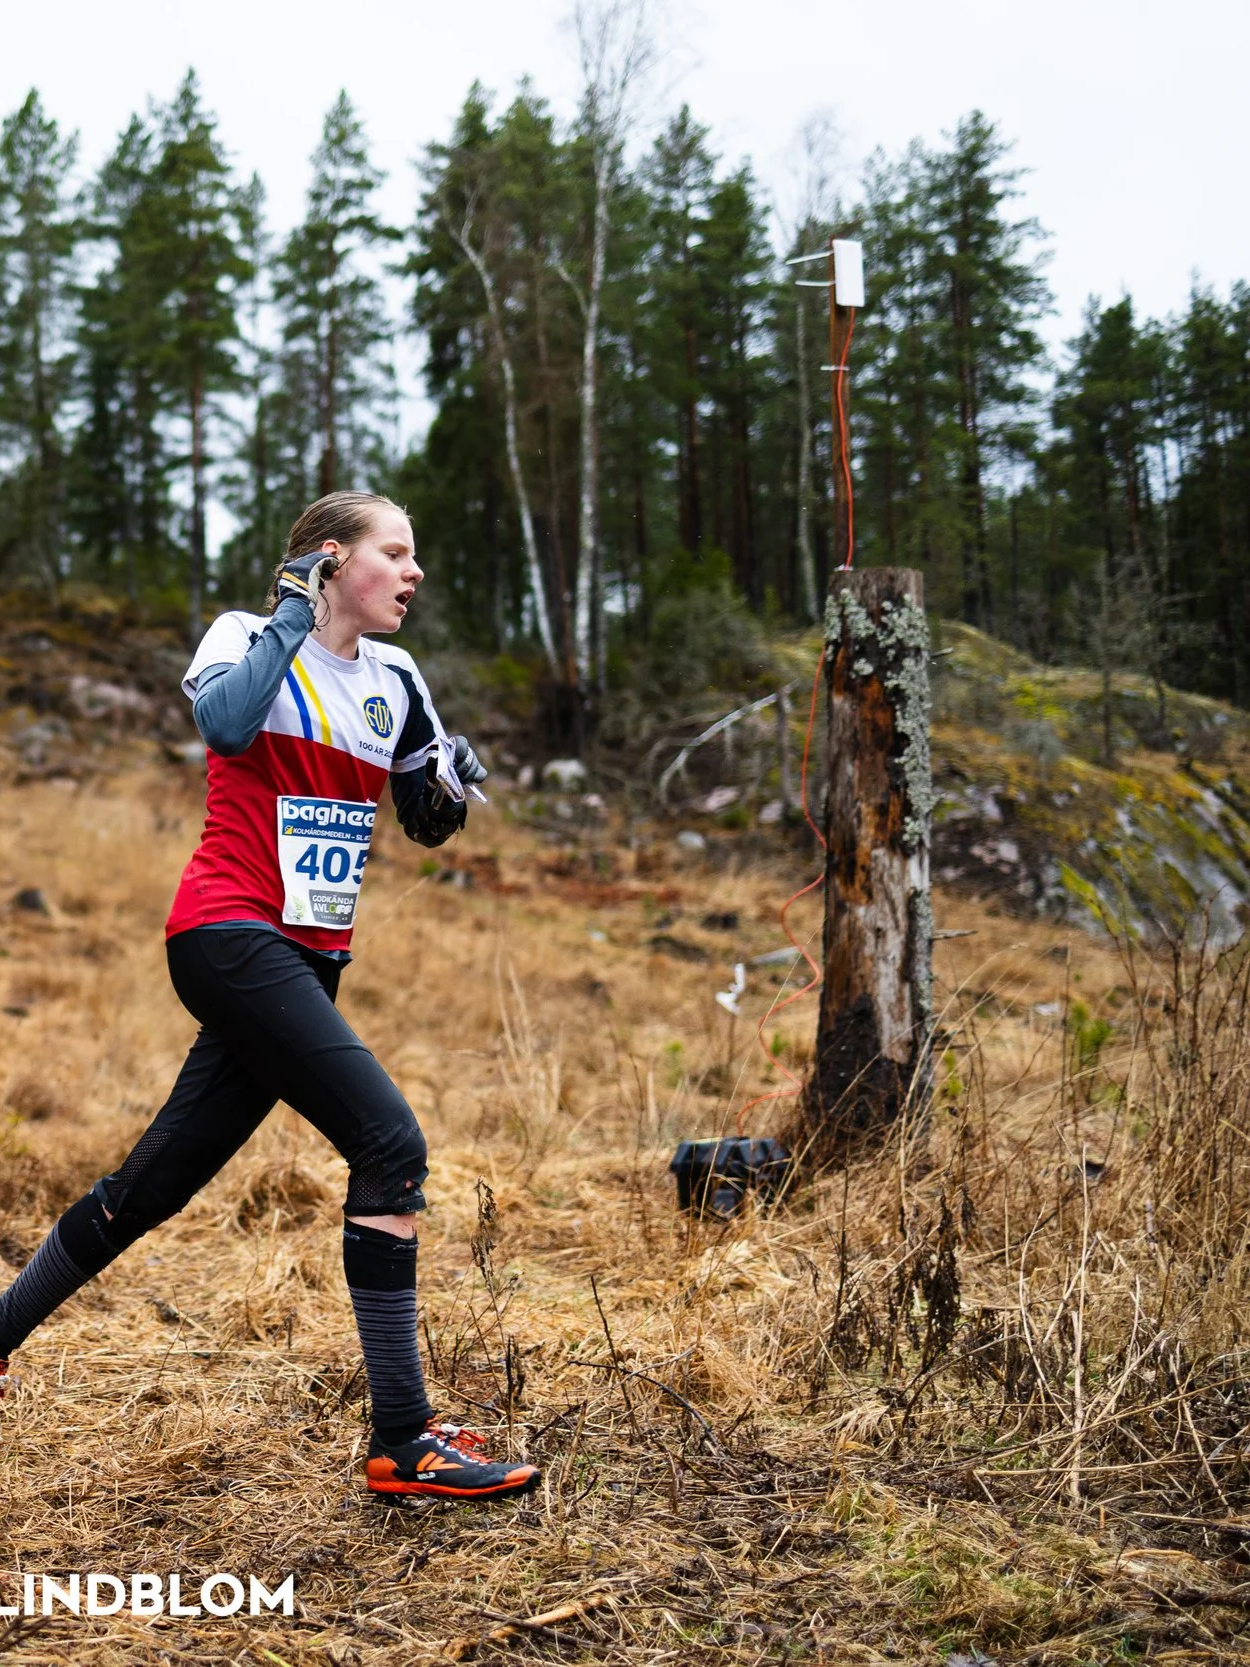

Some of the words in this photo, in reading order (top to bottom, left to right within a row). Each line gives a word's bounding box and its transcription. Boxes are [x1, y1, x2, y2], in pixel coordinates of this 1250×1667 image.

[359, 741, 373, 752] 100
[295, 843, 369, 885] 405
[312, 894, 354, 905] GODKÄNDA
